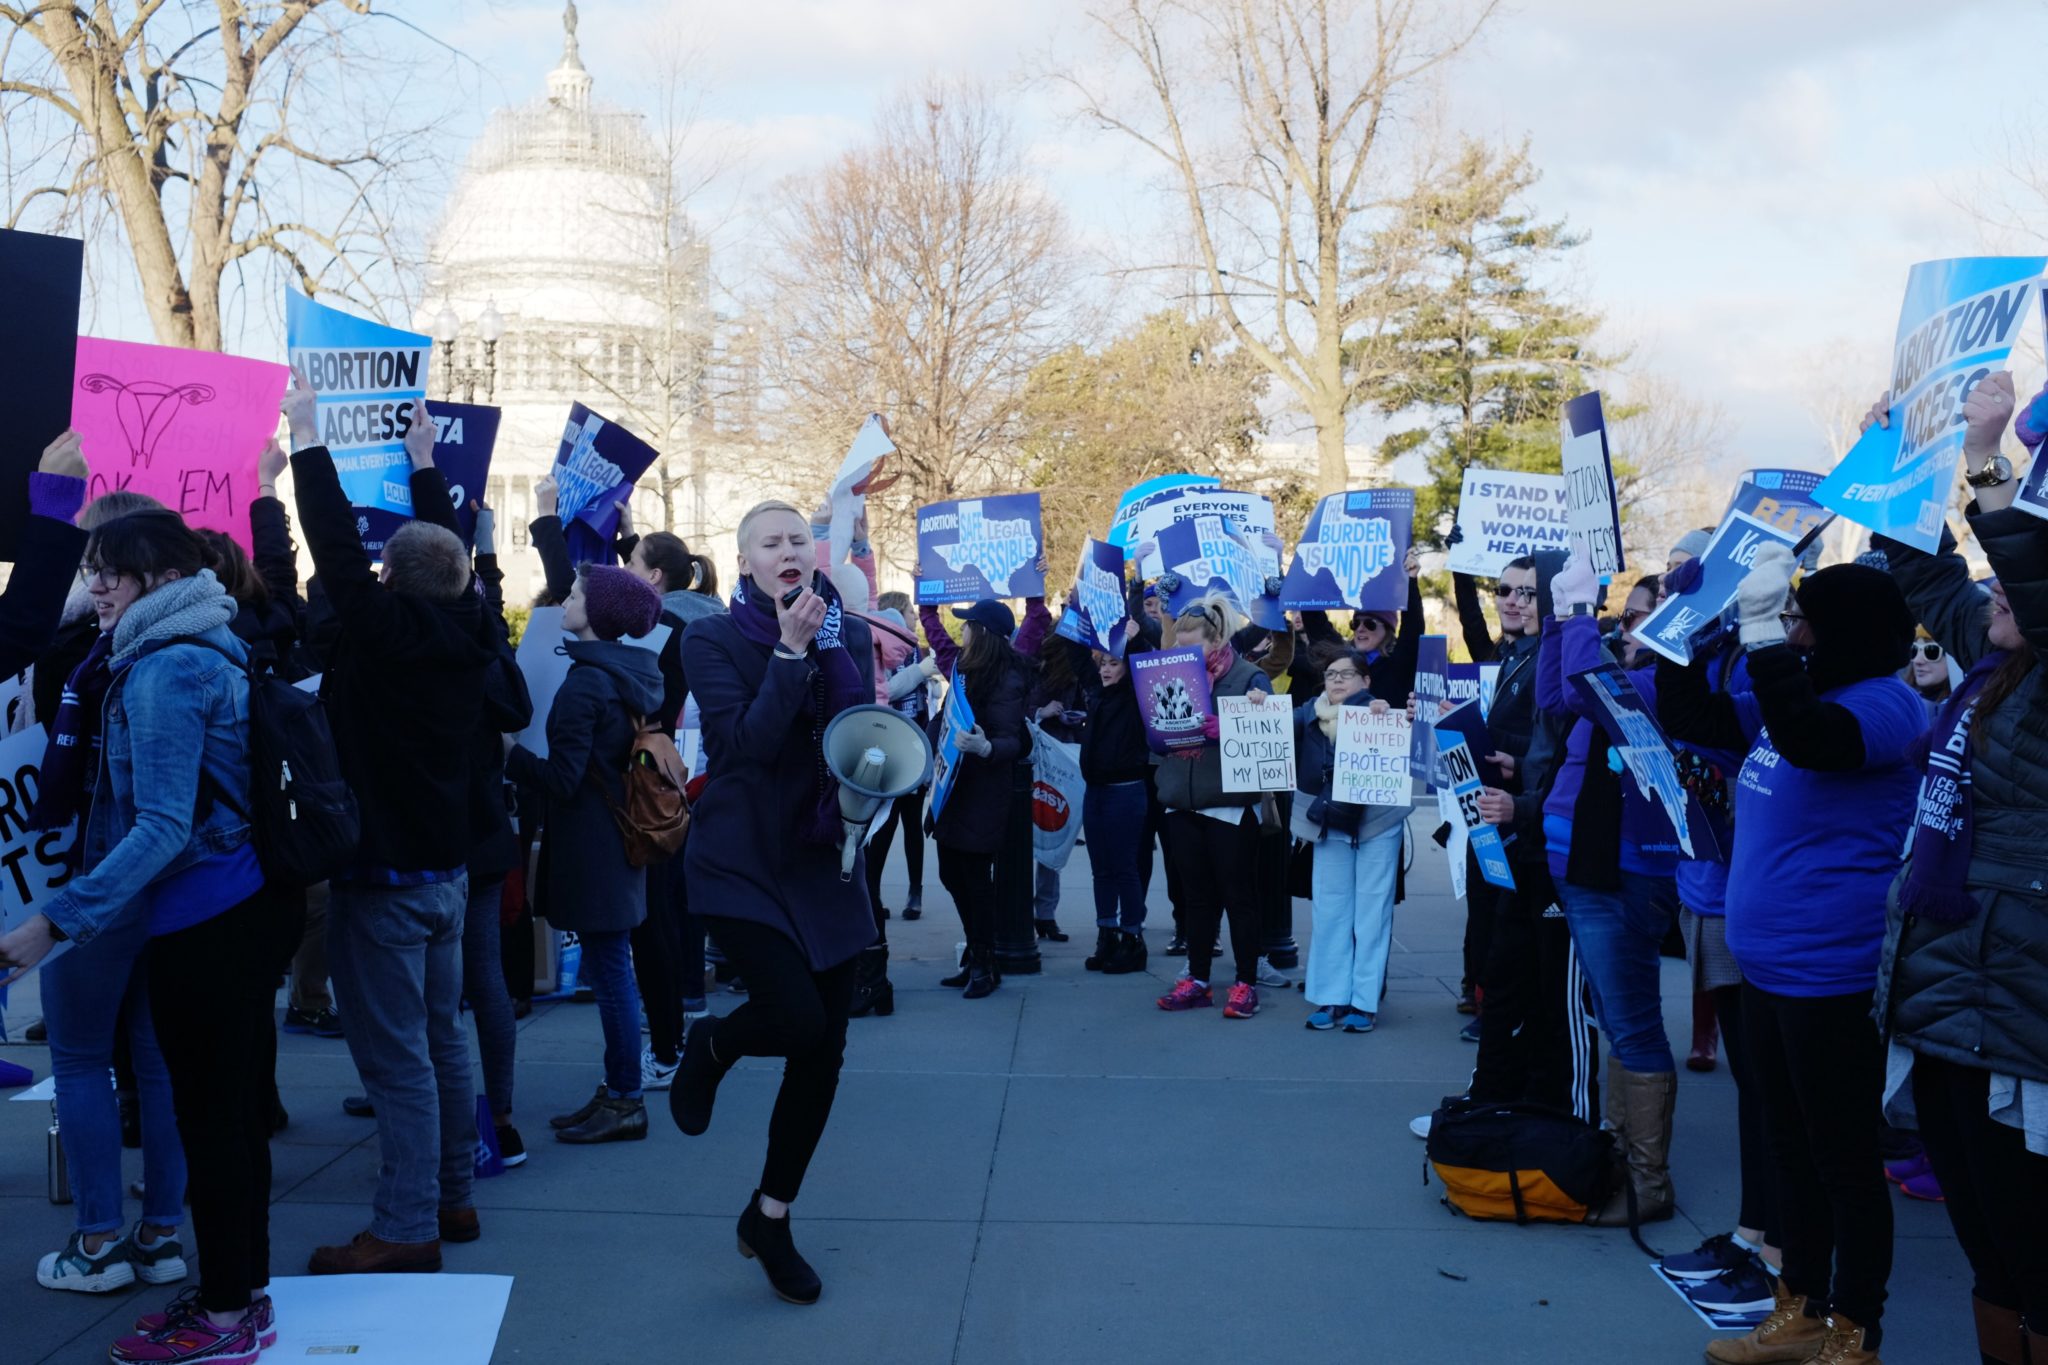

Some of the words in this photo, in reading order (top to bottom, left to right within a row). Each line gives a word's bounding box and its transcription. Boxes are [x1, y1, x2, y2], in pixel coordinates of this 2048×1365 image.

[1893, 284, 2030, 401] ABORTION
[324, 402, 415, 446] ACCESS
[433, 415, 464, 445] TA
[1566, 462, 1609, 512] RTION
[1785, 472, 1823, 483] NATION
[1469, 482, 1476, 497] I
[1480, 483, 1549, 503] STAND
[1173, 502, 1250, 514] EVERYONE
[1324, 500, 1344, 522] THE
[1496, 503, 1569, 524] WHOLE
[920, 513, 959, 535] ABORTION:
[987, 520, 1030, 540] LEGAL
[1197, 520, 1223, 540] THE
[1320, 521, 1388, 545] BURDEN
[949, 537, 1033, 583] ACCESSIBLE
[1202, 541, 1260, 572] BURDEN
[1189, 561, 1211, 582] IS
[1211, 558, 1264, 606] UNDUE
[1304, 546, 1322, 568] IS
[1323, 545, 1389, 598] UNDUE
[1135, 658, 1160, 669] DEAR
[1161, 653, 1198, 666] SCOTUS,
[1231, 716, 1283, 735] THINK
[1223, 738, 1291, 759] OUTSIDE
[1353, 731, 1406, 748] UNITED
[1338, 751, 1411, 774] PROTECT
[1232, 767, 1252, 784] MY
[1262, 767, 1285, 780] BOX
[1341, 771, 1403, 789] ABORTION
[1032, 786, 1067, 814] easy
[1349, 786, 1398, 805] ACCESS
